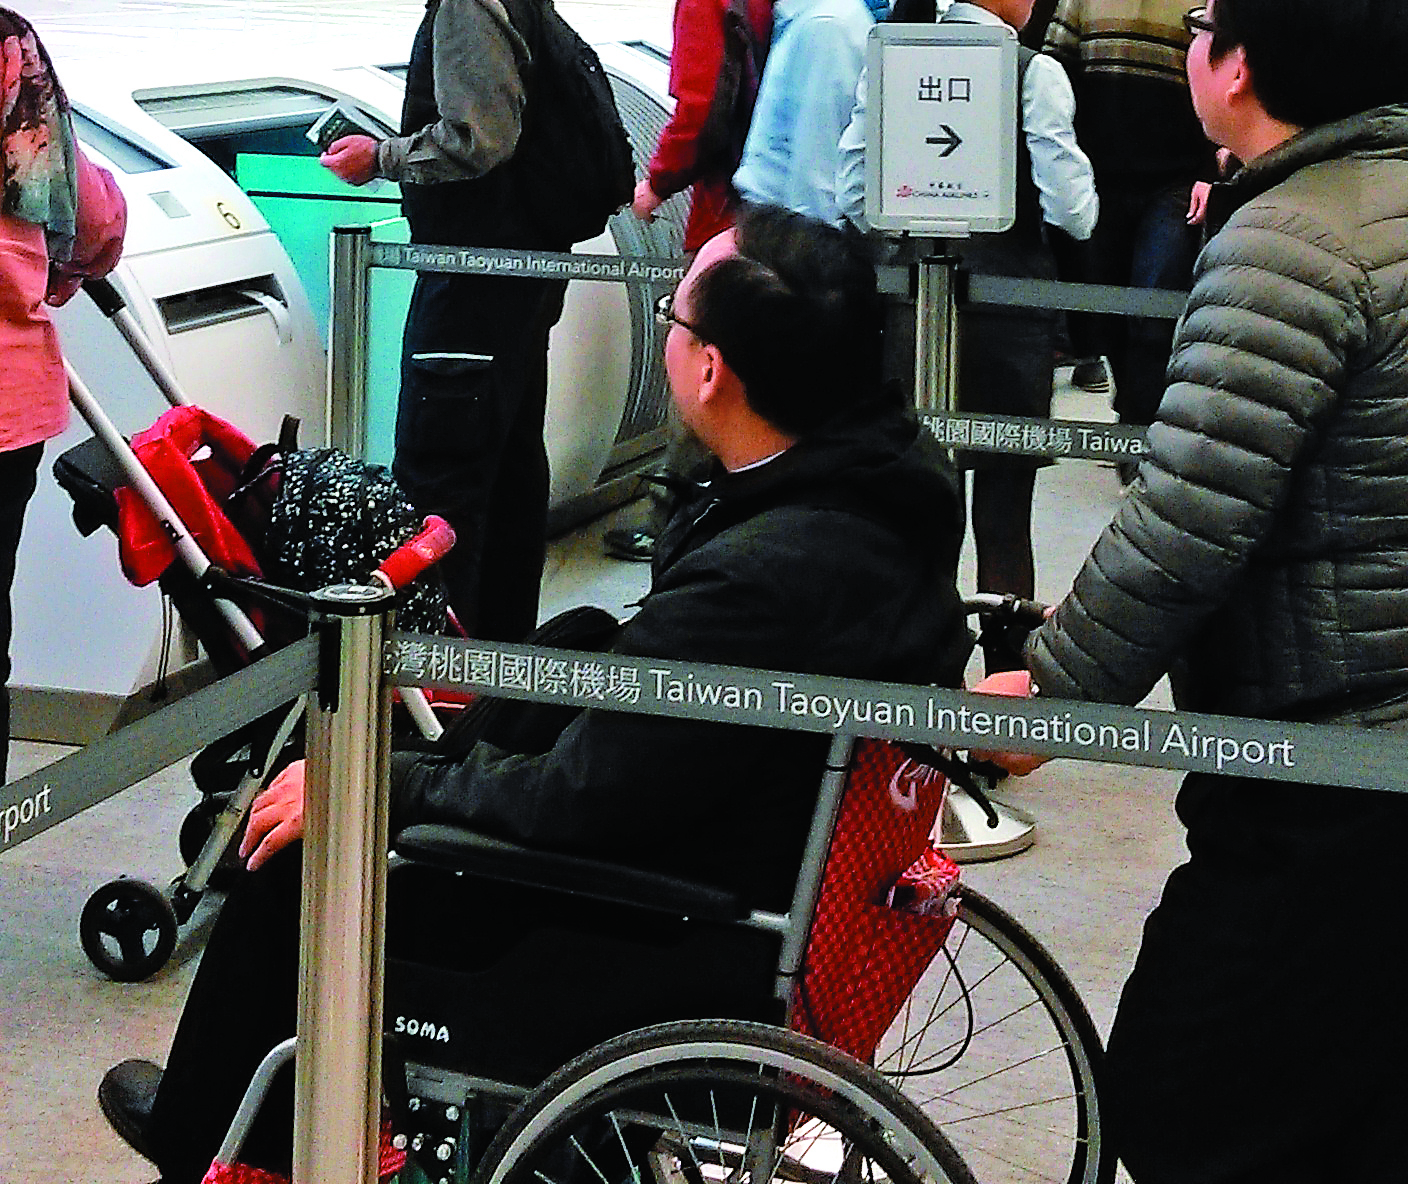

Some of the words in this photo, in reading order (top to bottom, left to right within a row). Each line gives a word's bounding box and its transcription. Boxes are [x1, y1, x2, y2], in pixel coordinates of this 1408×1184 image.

[918, 75, 971, 103] 出口
[216, 202, 241, 230] 6
[404, 247, 456, 265] Taiwan
[459, 250, 523, 271] Taoyuan
[526, 255, 625, 276] International
[628, 262, 685, 281] Airport
[1076, 428, 1143, 455] Taiwa
[648, 668, 763, 710] Taiwan
[773, 681, 915, 729] Taoyuan
[927, 697, 1150, 752] International
[1161, 722, 1295, 769] Airport
[394, 1015, 450, 1044] SOMA
